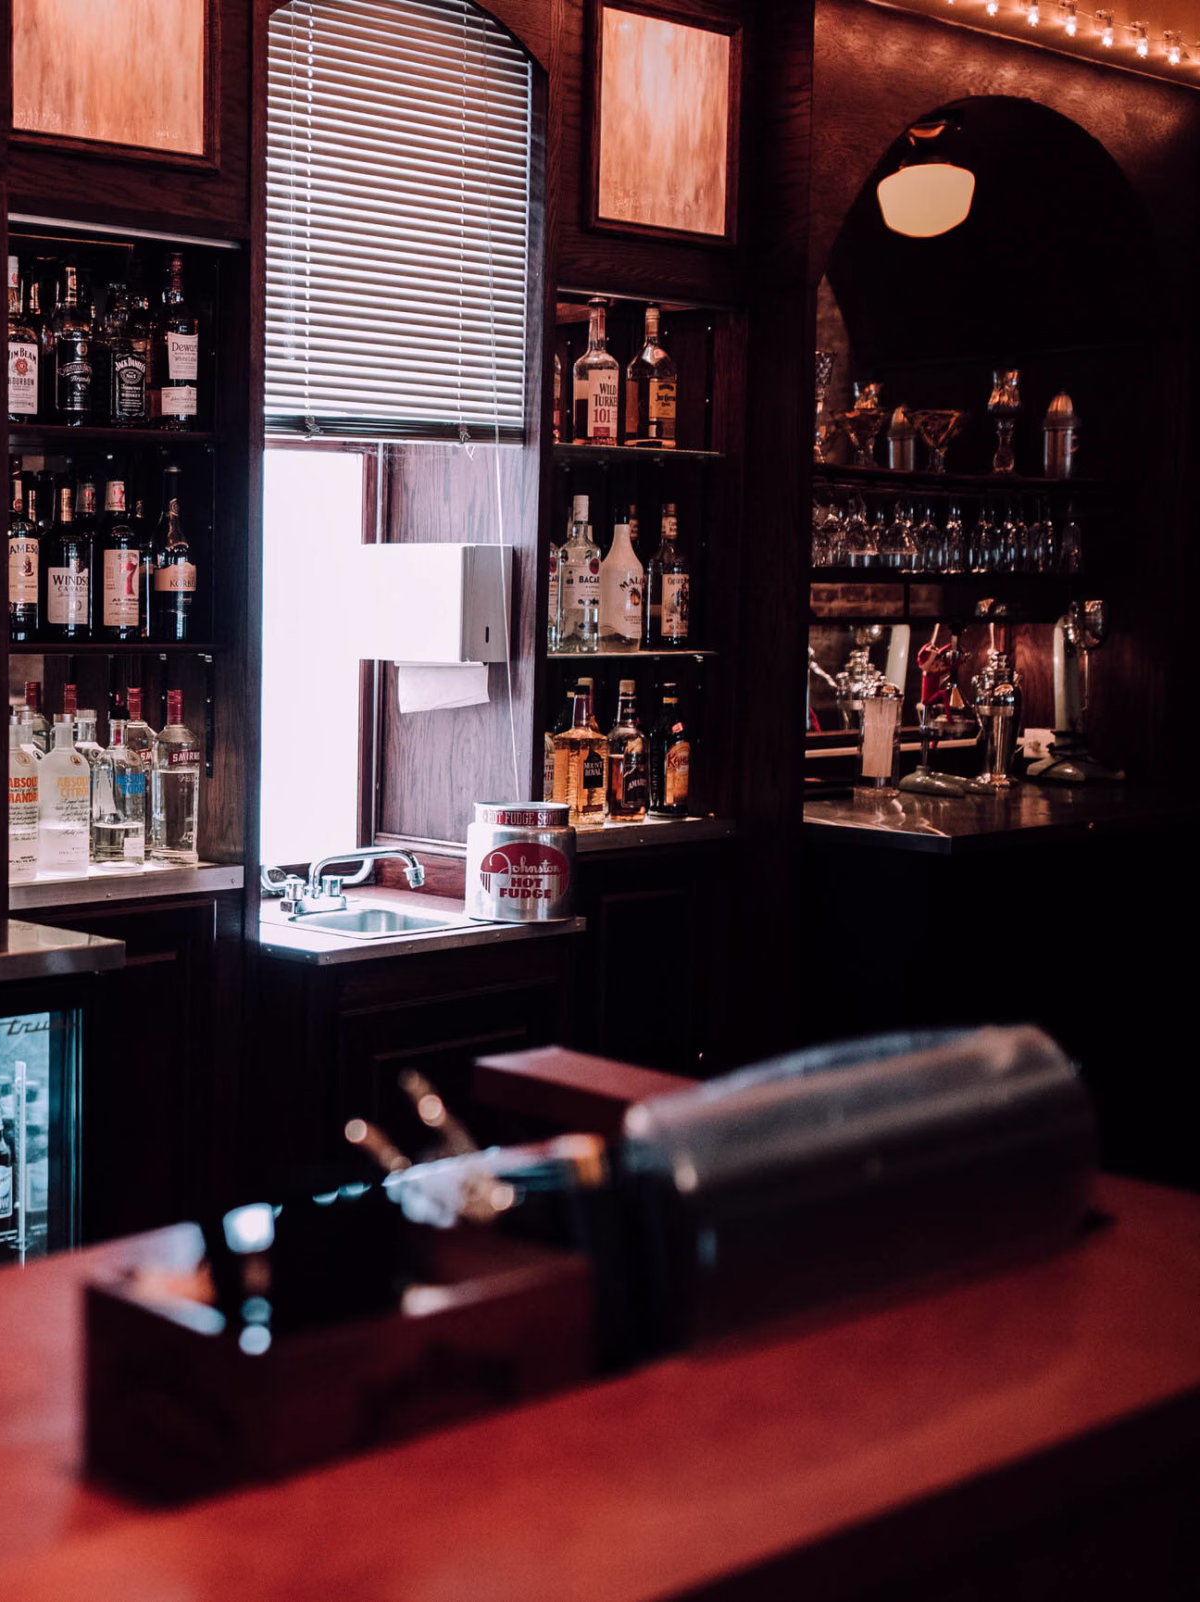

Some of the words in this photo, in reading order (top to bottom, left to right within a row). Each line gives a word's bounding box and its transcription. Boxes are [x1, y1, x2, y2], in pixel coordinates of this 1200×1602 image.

[115, 359, 128, 371] JACK
[600, 383, 617, 395] WILD
[593, 393, 618, 408] TURKE
[593, 408, 611, 424] 101
[504, 810, 535, 825] FUDGE
[488, 851, 560, 888] Johnston
[511, 878, 543, 888] HOT
[499, 888, 552, 899] FUDGE
